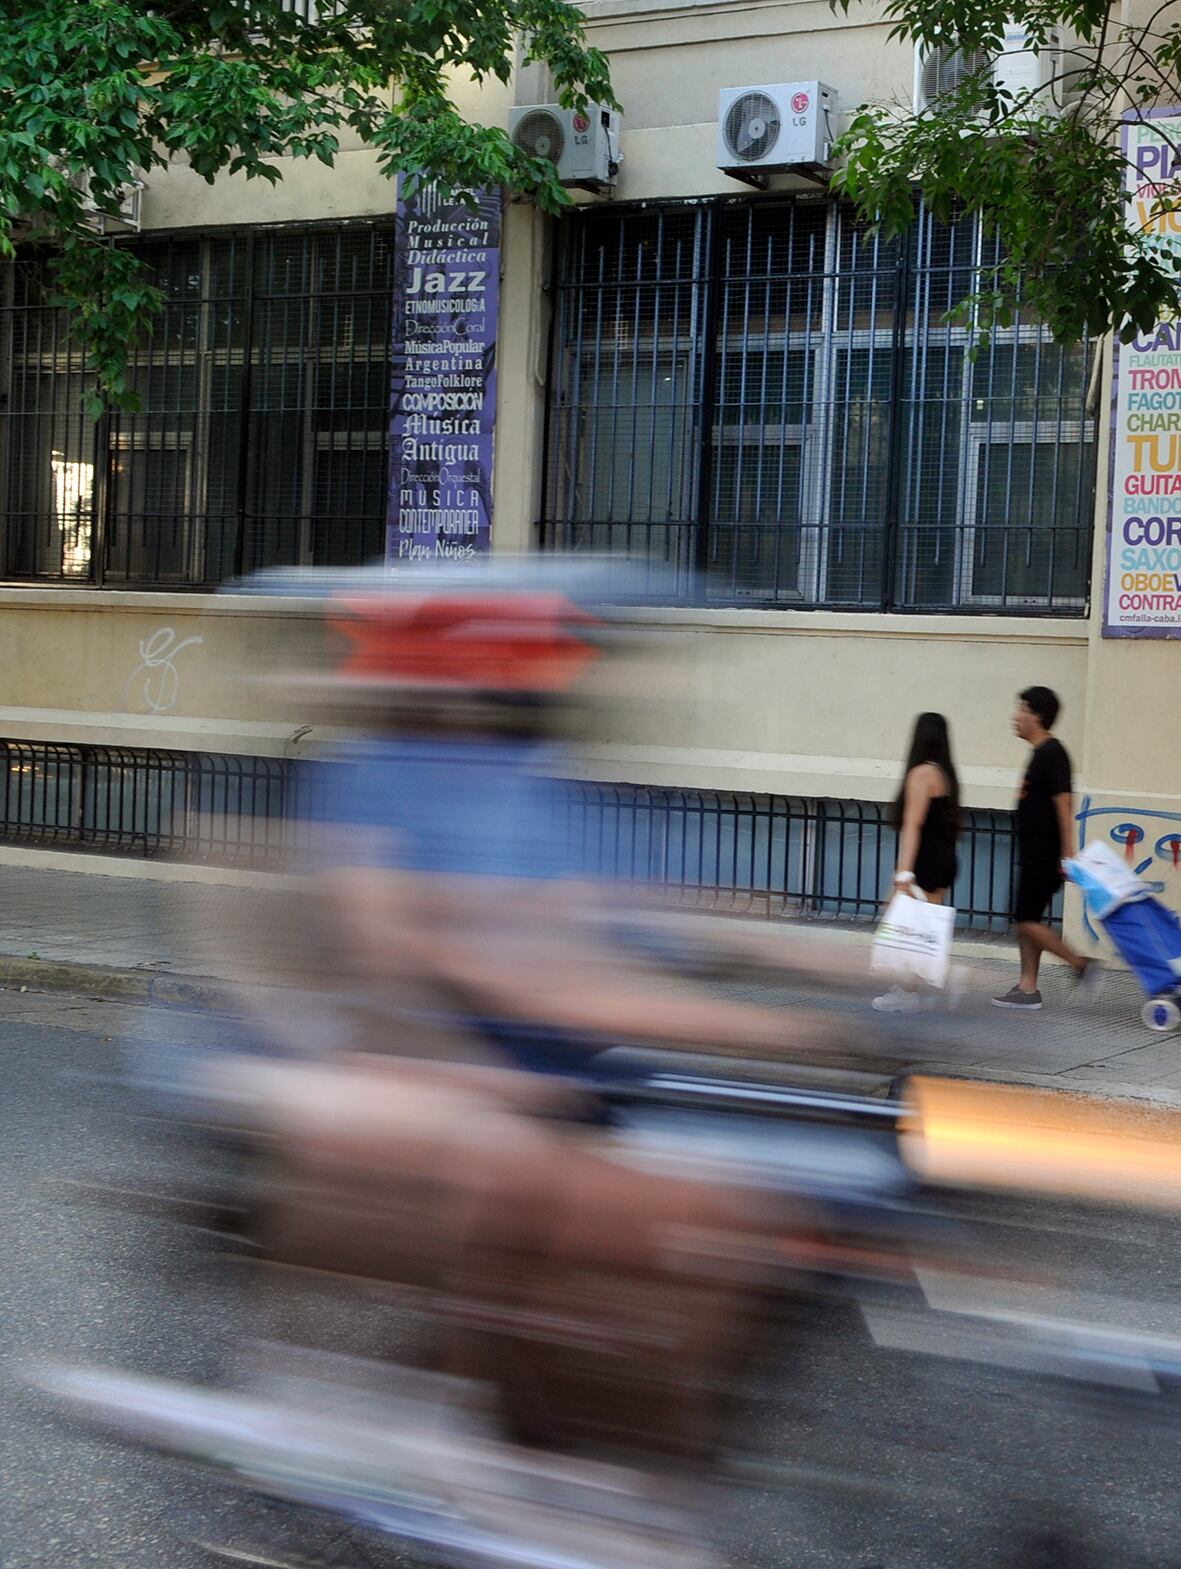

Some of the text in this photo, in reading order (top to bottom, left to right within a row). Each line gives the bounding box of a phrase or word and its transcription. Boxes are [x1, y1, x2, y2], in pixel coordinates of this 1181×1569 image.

[793, 117, 807, 127] LG
[574, 135, 588, 145] LG
[407, 217, 489, 234] Producción
[407, 231, 489, 249] Musical
[407, 248, 487, 265] Didáctica
[406, 267, 486, 294] Jazz
[405, 356, 483, 374] Argentina
[402, 387, 482, 411] COMPOSICIÓN
[402, 411, 480, 437] Música
[402, 437, 479, 465] Antigua
[400, 538, 477, 561] Plan Niños
